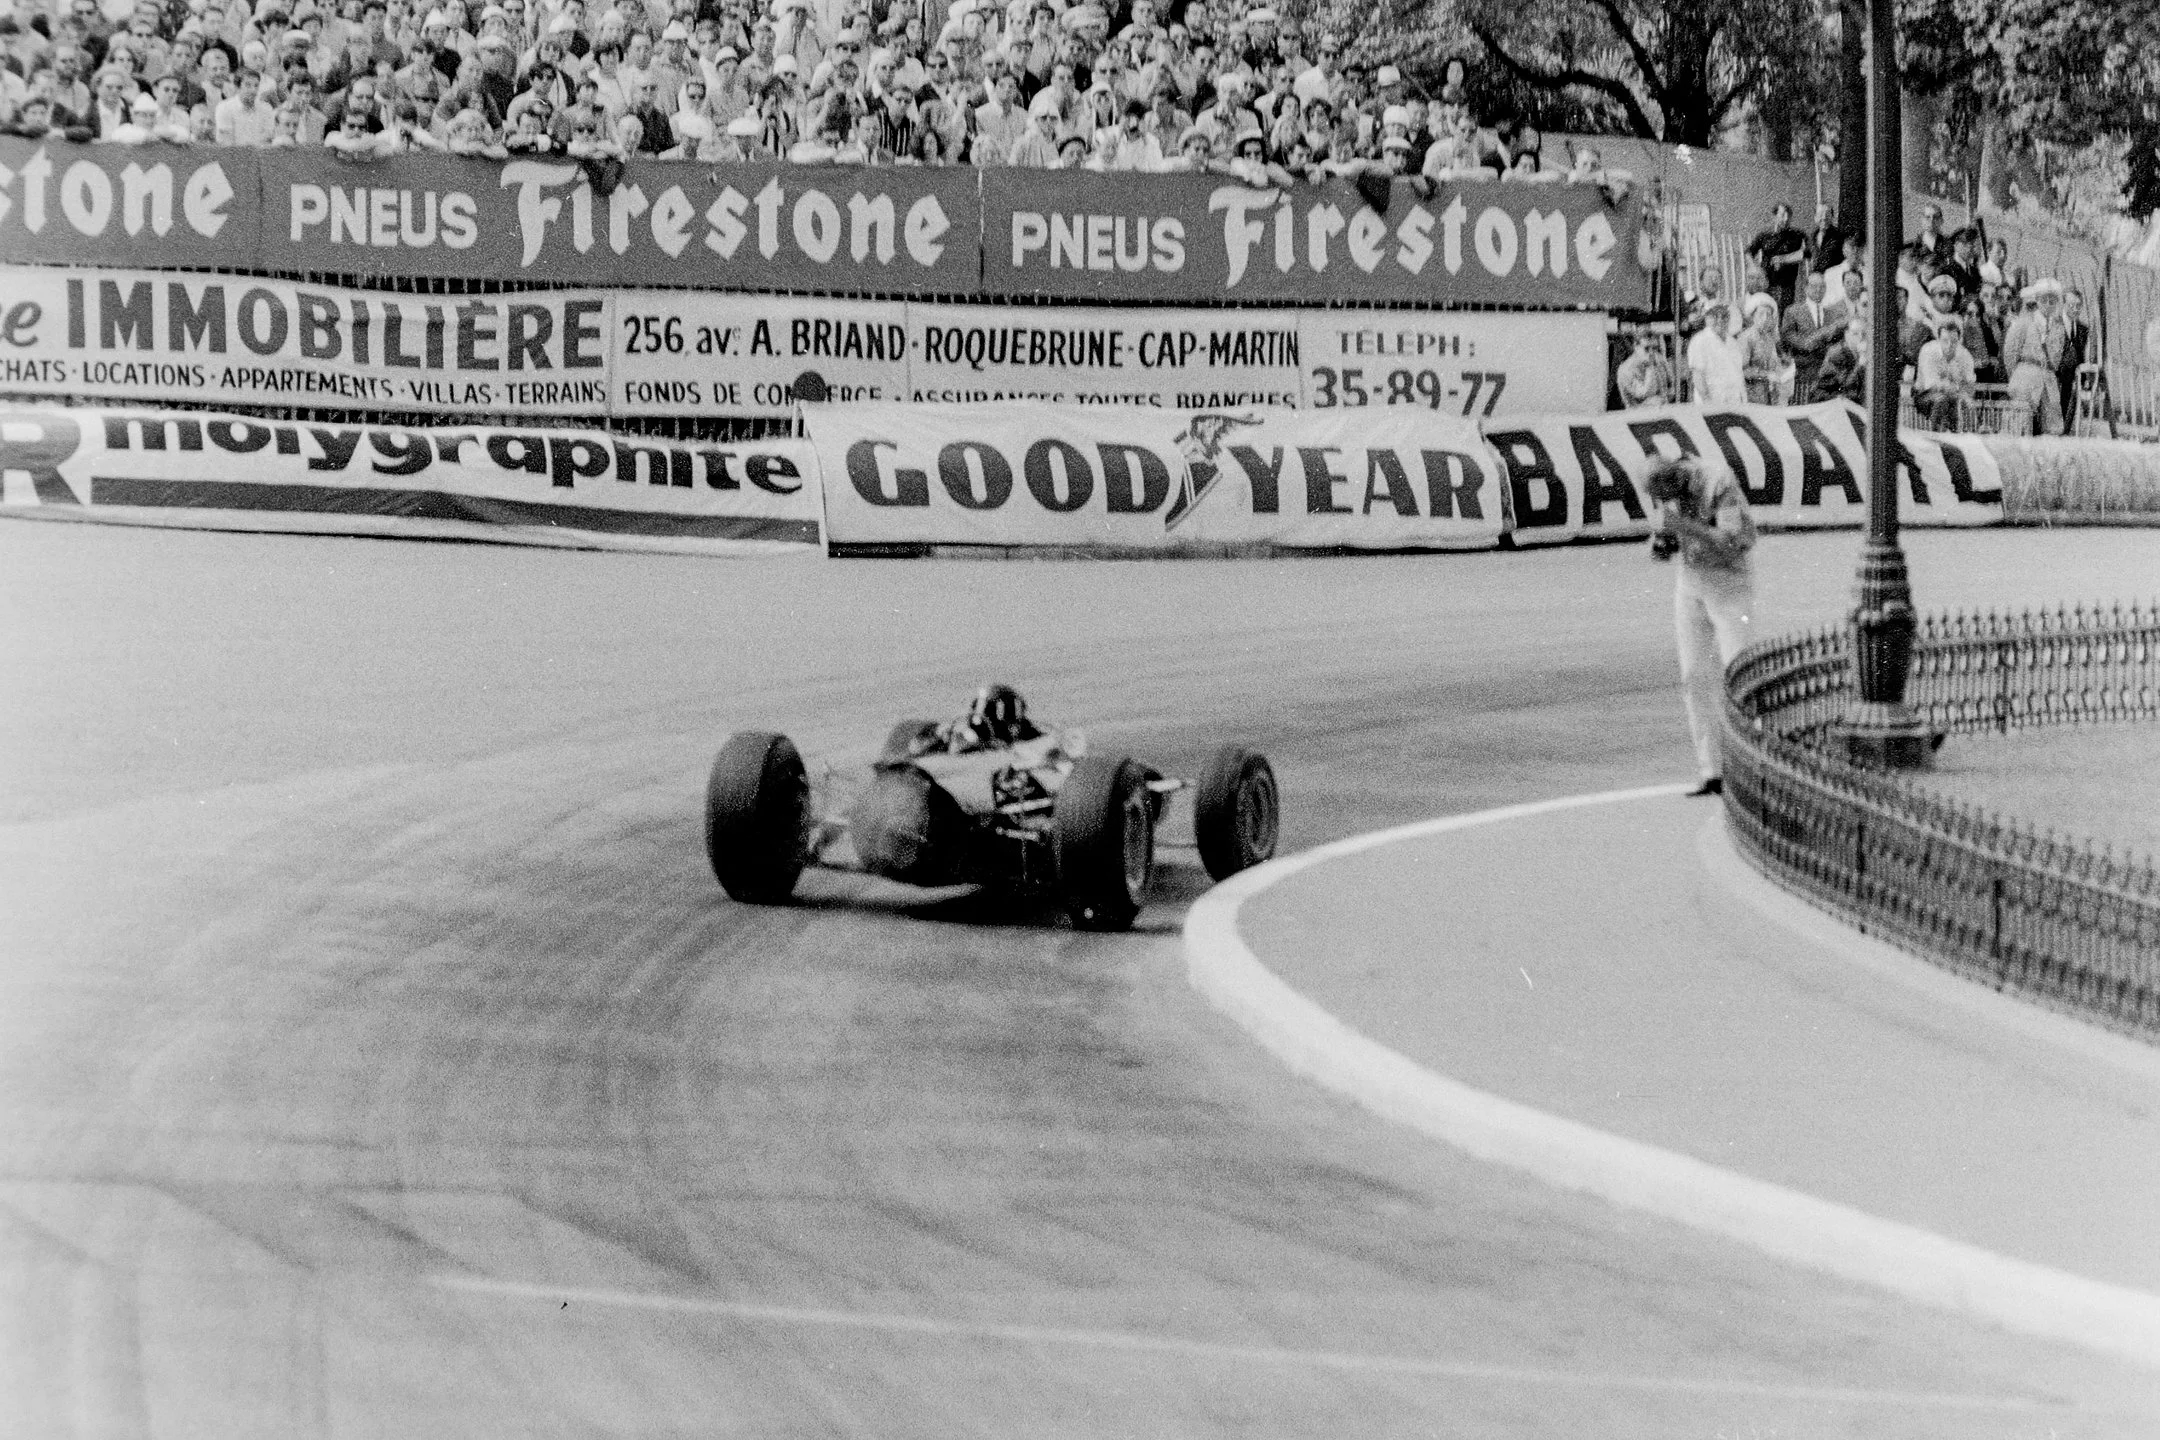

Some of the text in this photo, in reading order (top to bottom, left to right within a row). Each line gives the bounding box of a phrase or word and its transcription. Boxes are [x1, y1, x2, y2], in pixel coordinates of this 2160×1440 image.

[290, 160, 951, 268] PNEUS Firestone
[1011, 211, 1186, 272] PNEUS
[1208, 186, 1617, 289] Firestone
[750, 318, 782, 357] A.
[791, 318, 906, 361] BRIAND
[0, 359, 606, 405] HATS LOCATIONS APPARTEMENTS VILLAS TERRAINS
[625, 381, 701, 405] FONDS
[713, 382, 741, 405] DE
[754, 382, 881, 407] COMERCE
[1312, 366, 1507, 417] 35-89-77
[845, 437, 1486, 520] GOOD YEAR
